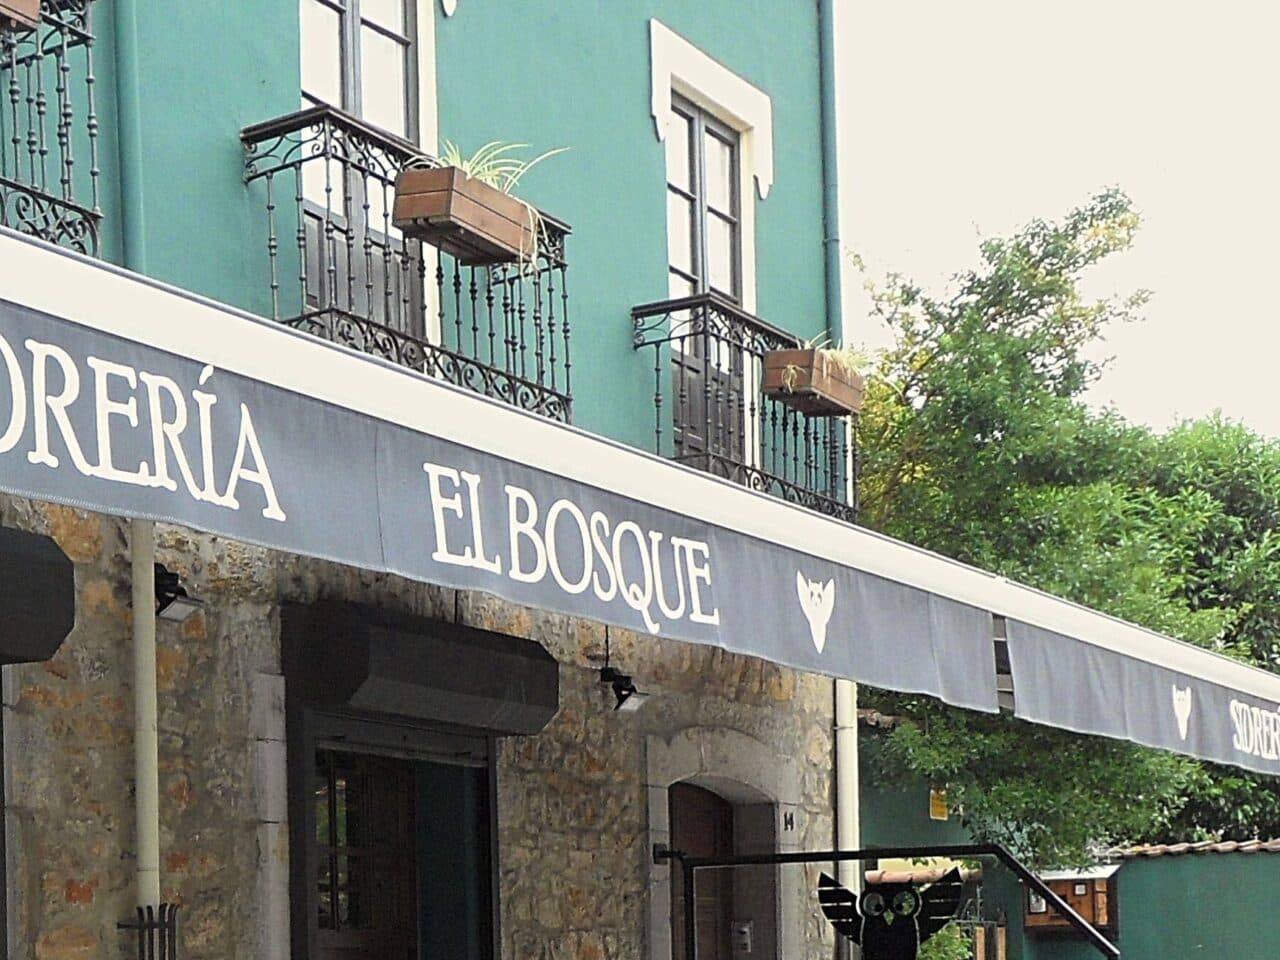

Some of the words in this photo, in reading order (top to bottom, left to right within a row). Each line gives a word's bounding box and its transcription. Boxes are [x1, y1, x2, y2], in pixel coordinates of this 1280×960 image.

[423, 462, 502, 575] EL
[504, 485, 721, 635] BOSQUE
[1229, 698, 1280, 761] SIDRER
